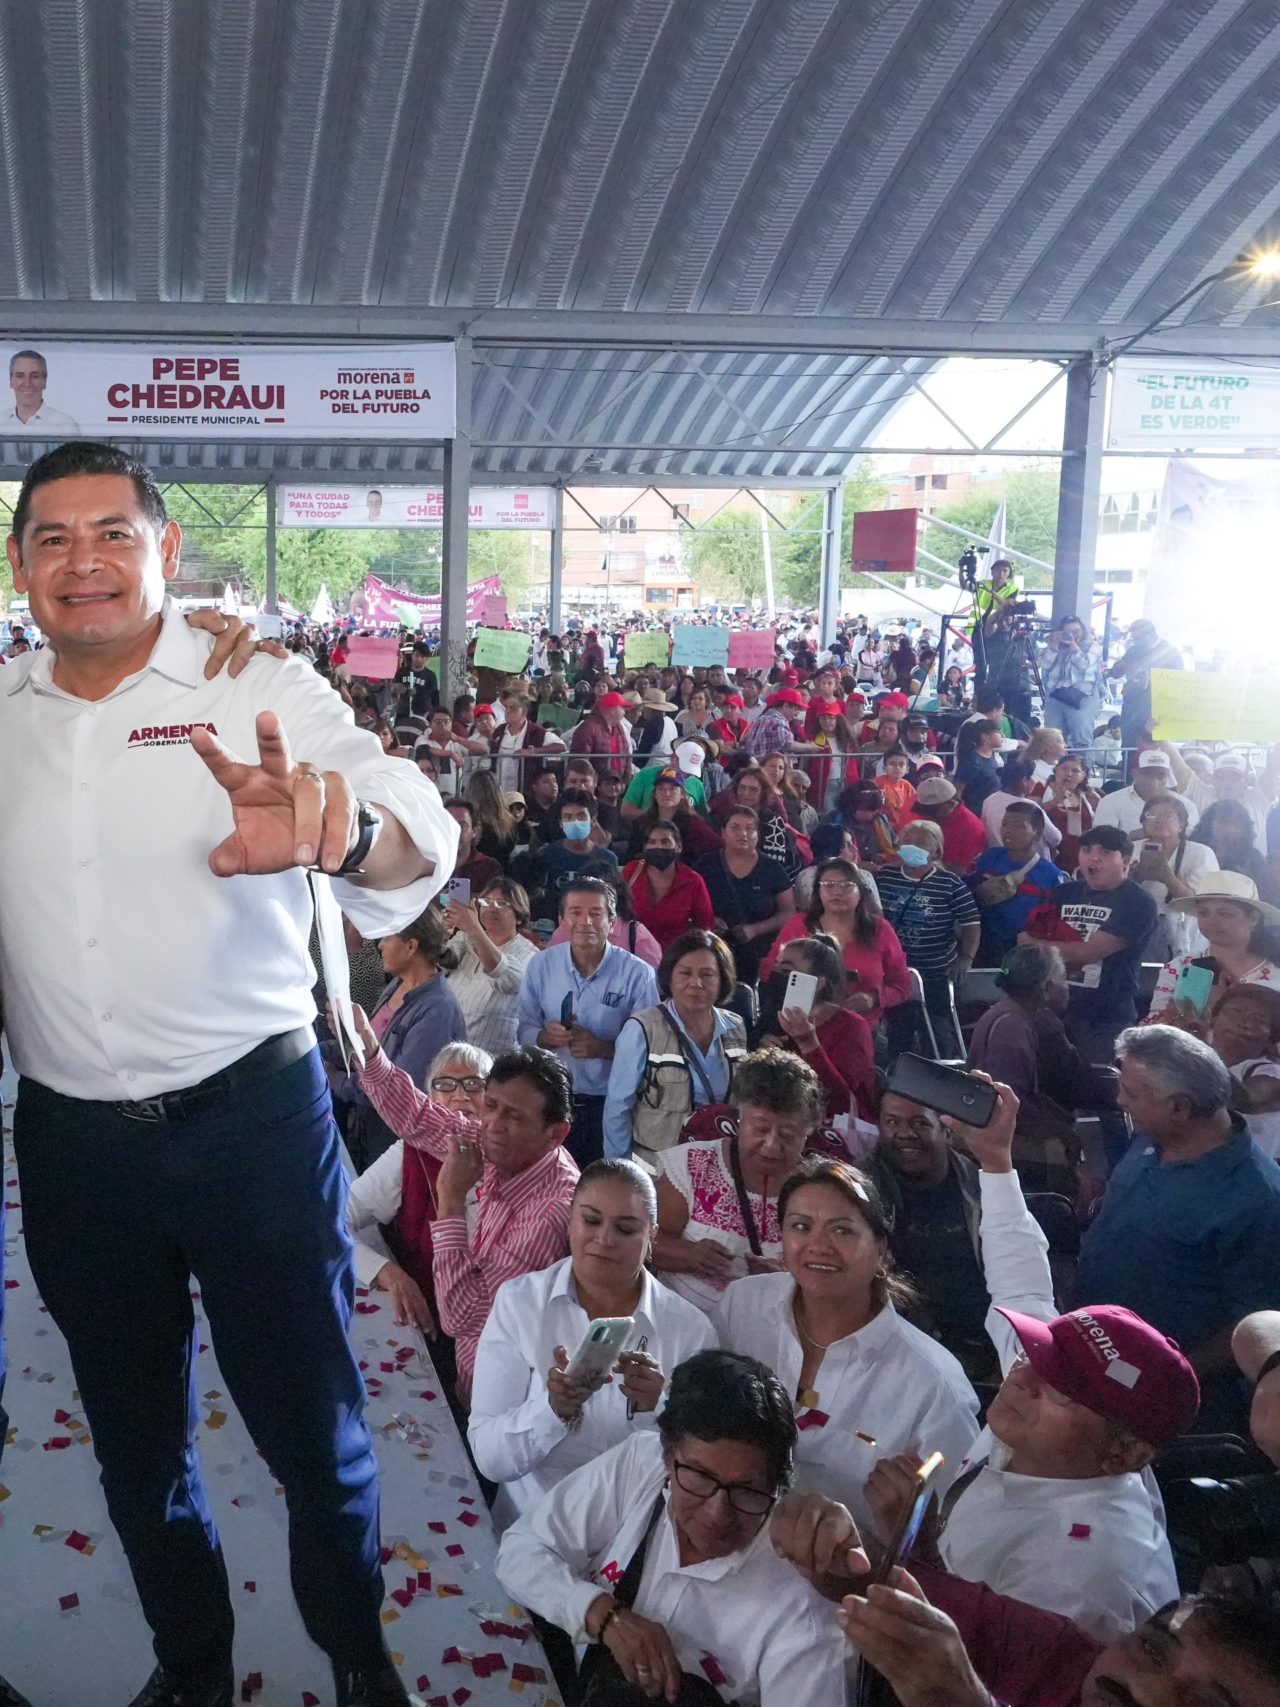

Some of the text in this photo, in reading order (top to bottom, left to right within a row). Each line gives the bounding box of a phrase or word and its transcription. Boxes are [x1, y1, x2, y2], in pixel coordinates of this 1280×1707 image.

[152, 358, 240, 381] PEPE
[337, 372, 401, 384] morena
[1173, 375, 1250, 390] FUTURO
[107, 383, 285, 410] CHEDRAUI
[320, 389, 431, 400] POR LA PUEBLA
[332, 402, 420, 413] DEL FUTURO
[1150, 395, 1233, 410] DE LA 4T
[132, 415, 260, 425] PRESIDENTE MUNICIPAL
[1140, 415, 1241, 430] ES VERDE”
[315, 492, 350, 500] CIUDAD
[364, 619, 376, 628] LA
[143, 738, 193, 747] GOBERNAD
[1064, 907, 1107, 919] WANTED
[1073, 1309, 1120, 1361] morena
